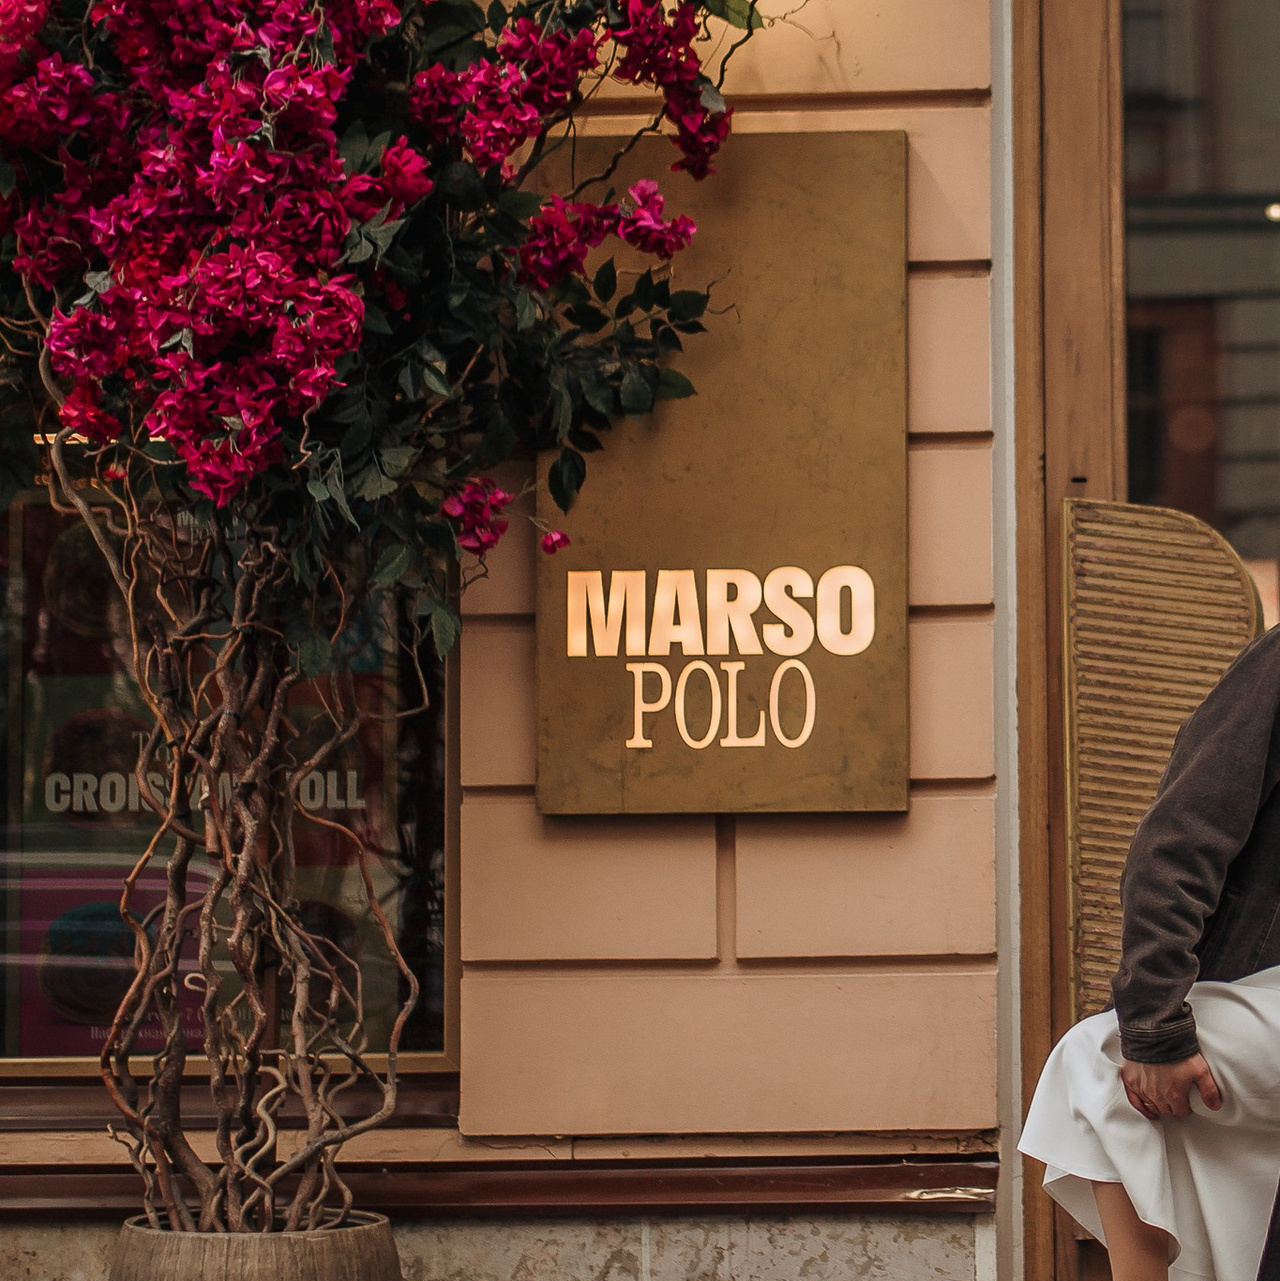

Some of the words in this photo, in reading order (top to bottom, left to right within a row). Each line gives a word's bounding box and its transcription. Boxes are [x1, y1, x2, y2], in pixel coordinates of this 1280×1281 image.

[567, 565, 875, 657] MARSO
[625, 658, 816, 749] POLO
[286, 769, 366, 810] OLL
